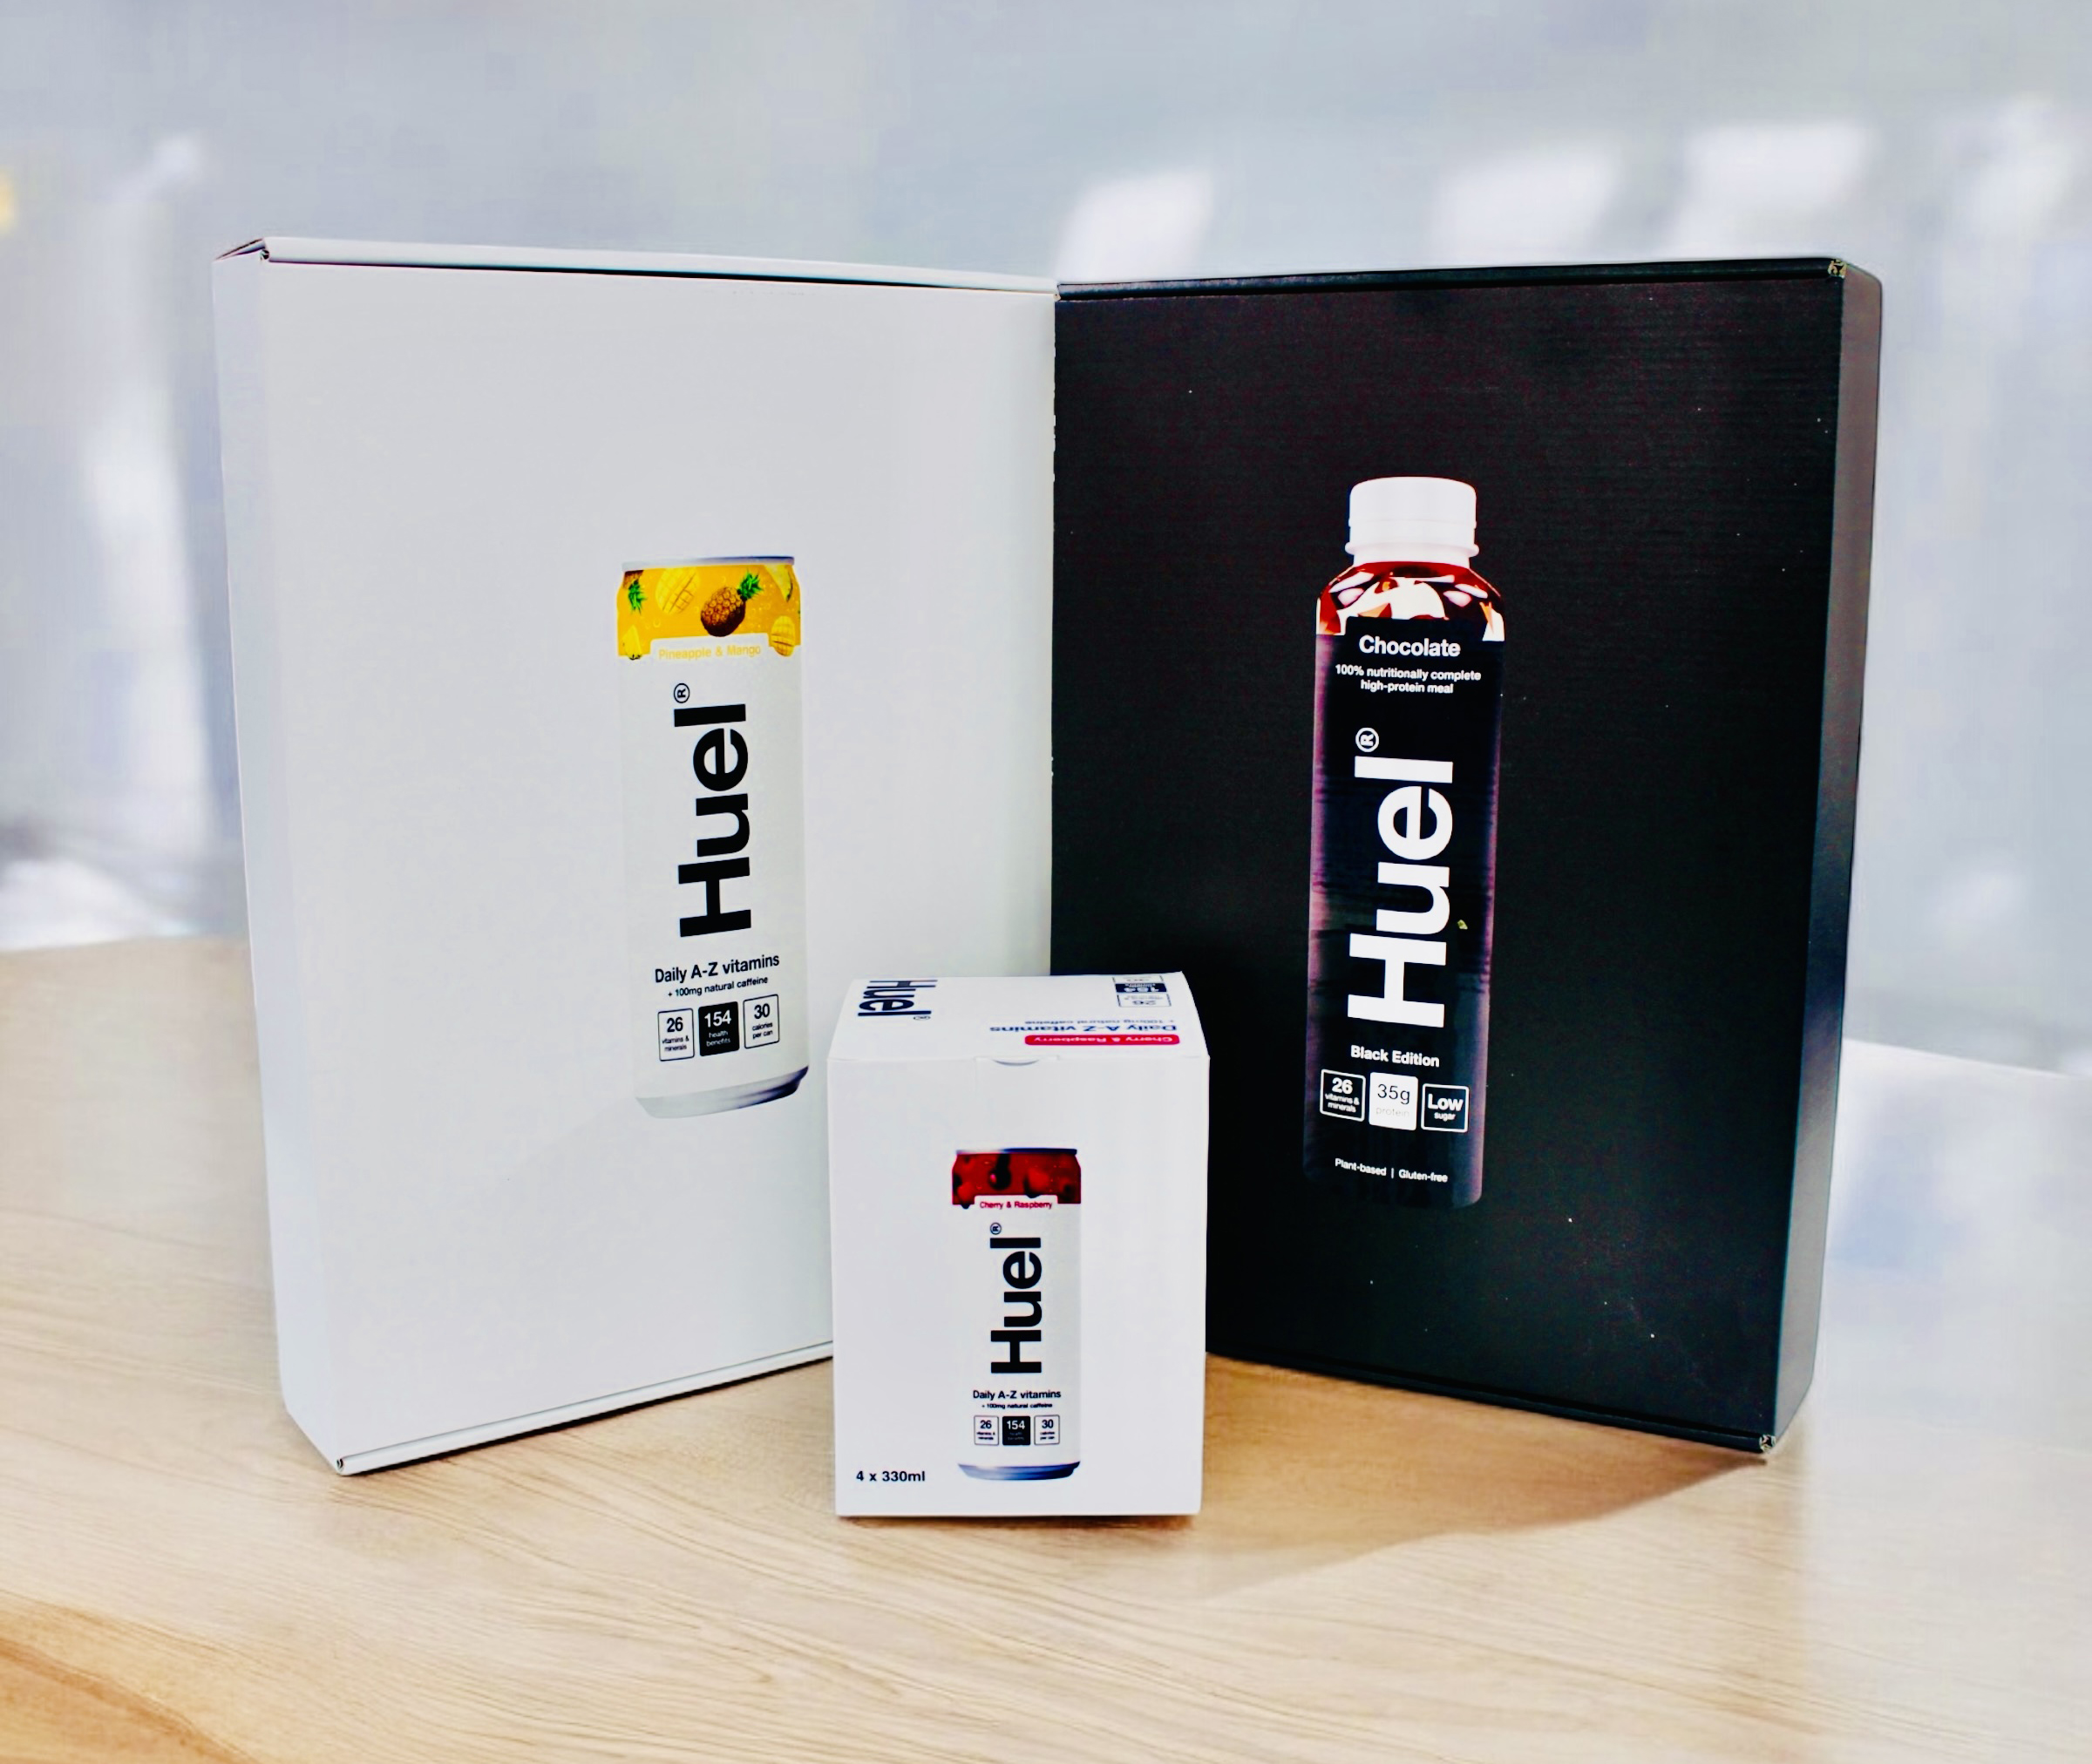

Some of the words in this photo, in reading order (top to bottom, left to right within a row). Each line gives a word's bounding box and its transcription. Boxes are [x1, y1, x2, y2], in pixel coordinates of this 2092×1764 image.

[1359, 634, 1461, 657] Chocolate
[658, 648, 711, 661] Pineapple
[715, 646, 723, 657] &
[727, 644, 761, 657] Mango
[1335, 664, 1364, 676] 100%
[1367, 668, 1429, 682] nutritionally
[1430, 669, 1481, 682] complete
[1361, 680, 1424, 693] high-protein
[1427, 683, 1454, 694] meal
[655, 967, 687, 984] Daily
[690, 961, 718, 980] A-Z
[723, 954, 780, 974] vitamins
[675, 987, 703, 996] 100mg
[704, 981, 734, 994] natural
[737, 976, 768, 988] caffeine
[754, 1003, 771, 1020] 30
[667, 1017, 683, 1033] 26
[704, 1009, 731, 1028] 154
[662, 1035, 683, 1044] vitamins
[709, 1029, 728, 1038] health
[752, 1031, 762, 1040] per
[706, 1037, 730, 1047] benefits
[1351, 1044, 1389, 1062] Black
[1392, 1050, 1440, 1068] Edition
[1332, 1077, 1353, 1095] 26
[1325, 1092, 1353, 1104] vitamins
[1377, 1083, 1410, 1105] 35g
[1328, 1101, 1356, 1113] minerals
[1428, 1093, 1464, 1111] Low
[1375, 1108, 1409, 1117] protein
[1434, 1111, 1456, 1122] sugar
[1335, 1158, 1387, 1177] Plant-based
[1398, 1169, 1449, 1183] Gluten-free
[980, 1201, 1002, 1210] Cherry
[1015, 1201, 1052, 1210] Raspberry
[973, 1390, 995, 1401] Daily
[998, 1390, 1017, 1399] A-Z
[1020, 1390, 1061, 1399] vitamins
[980, 1420, 992, 1429] 26
[1007, 1420, 1025, 1430] 154
[1042, 1419, 1054, 1428] 30
[856, 1470, 864, 1482] 4
[869, 1473, 877, 1482] x
[882, 1470, 925, 1482] 330ml
